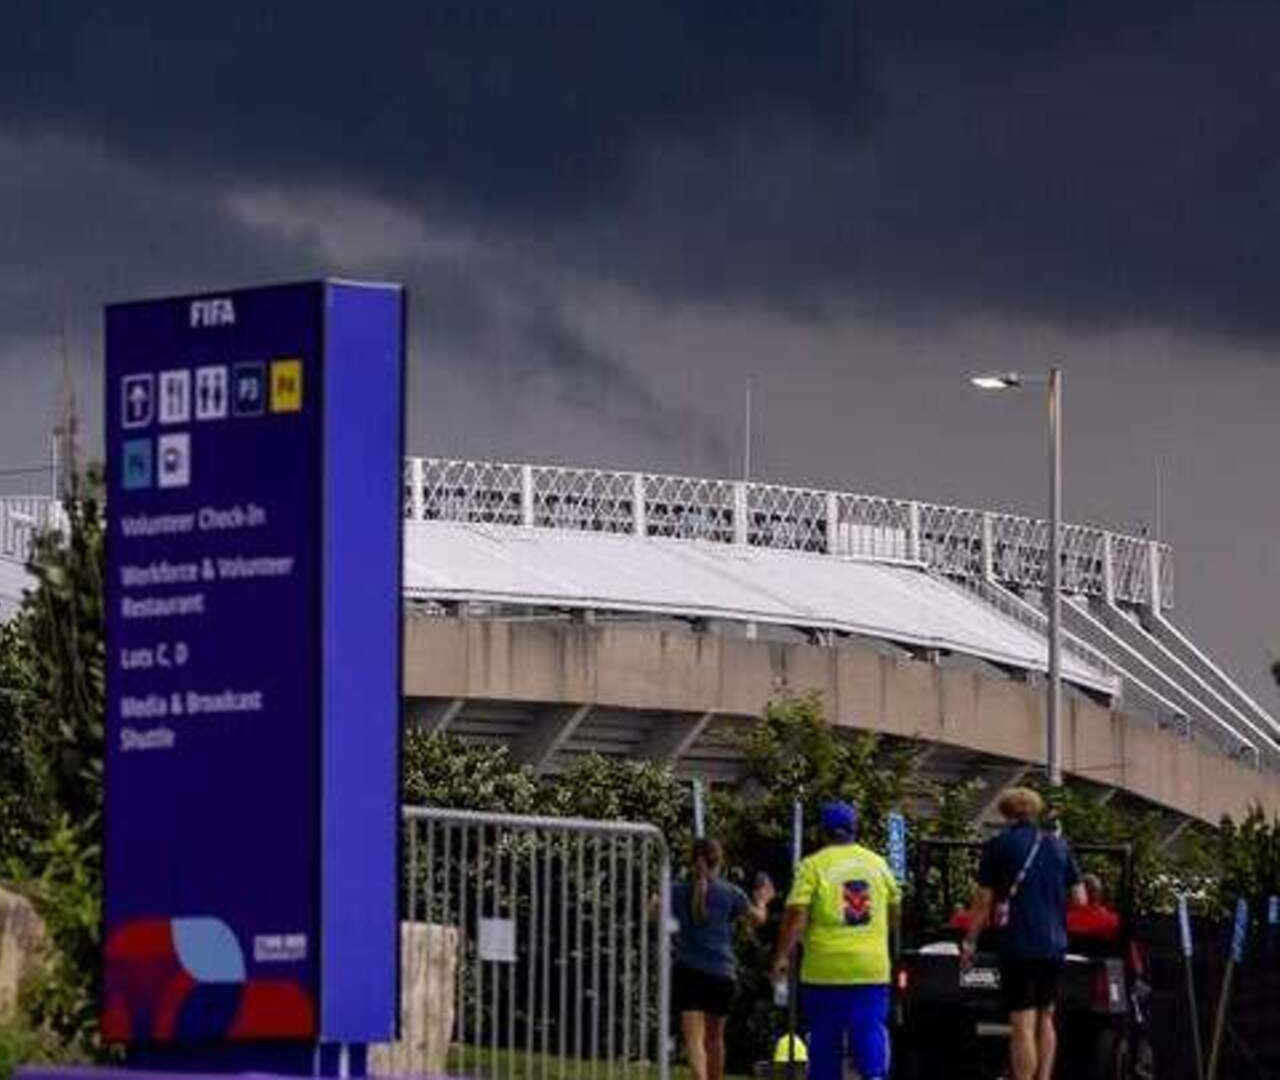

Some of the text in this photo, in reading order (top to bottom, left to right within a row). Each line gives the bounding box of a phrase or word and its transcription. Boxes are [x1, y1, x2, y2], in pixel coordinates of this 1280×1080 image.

[189, 298, 236, 329] FIFA
[122, 506, 266, 535] Volunteer Check-In
[121, 558, 294, 585] Workforce & Volunteer
[122, 595, 204, 616] Restaurant
[122, 650, 152, 667] Lots
[122, 691, 262, 716] Media & Broadcast
[121, 729, 174, 749] Shuttle
